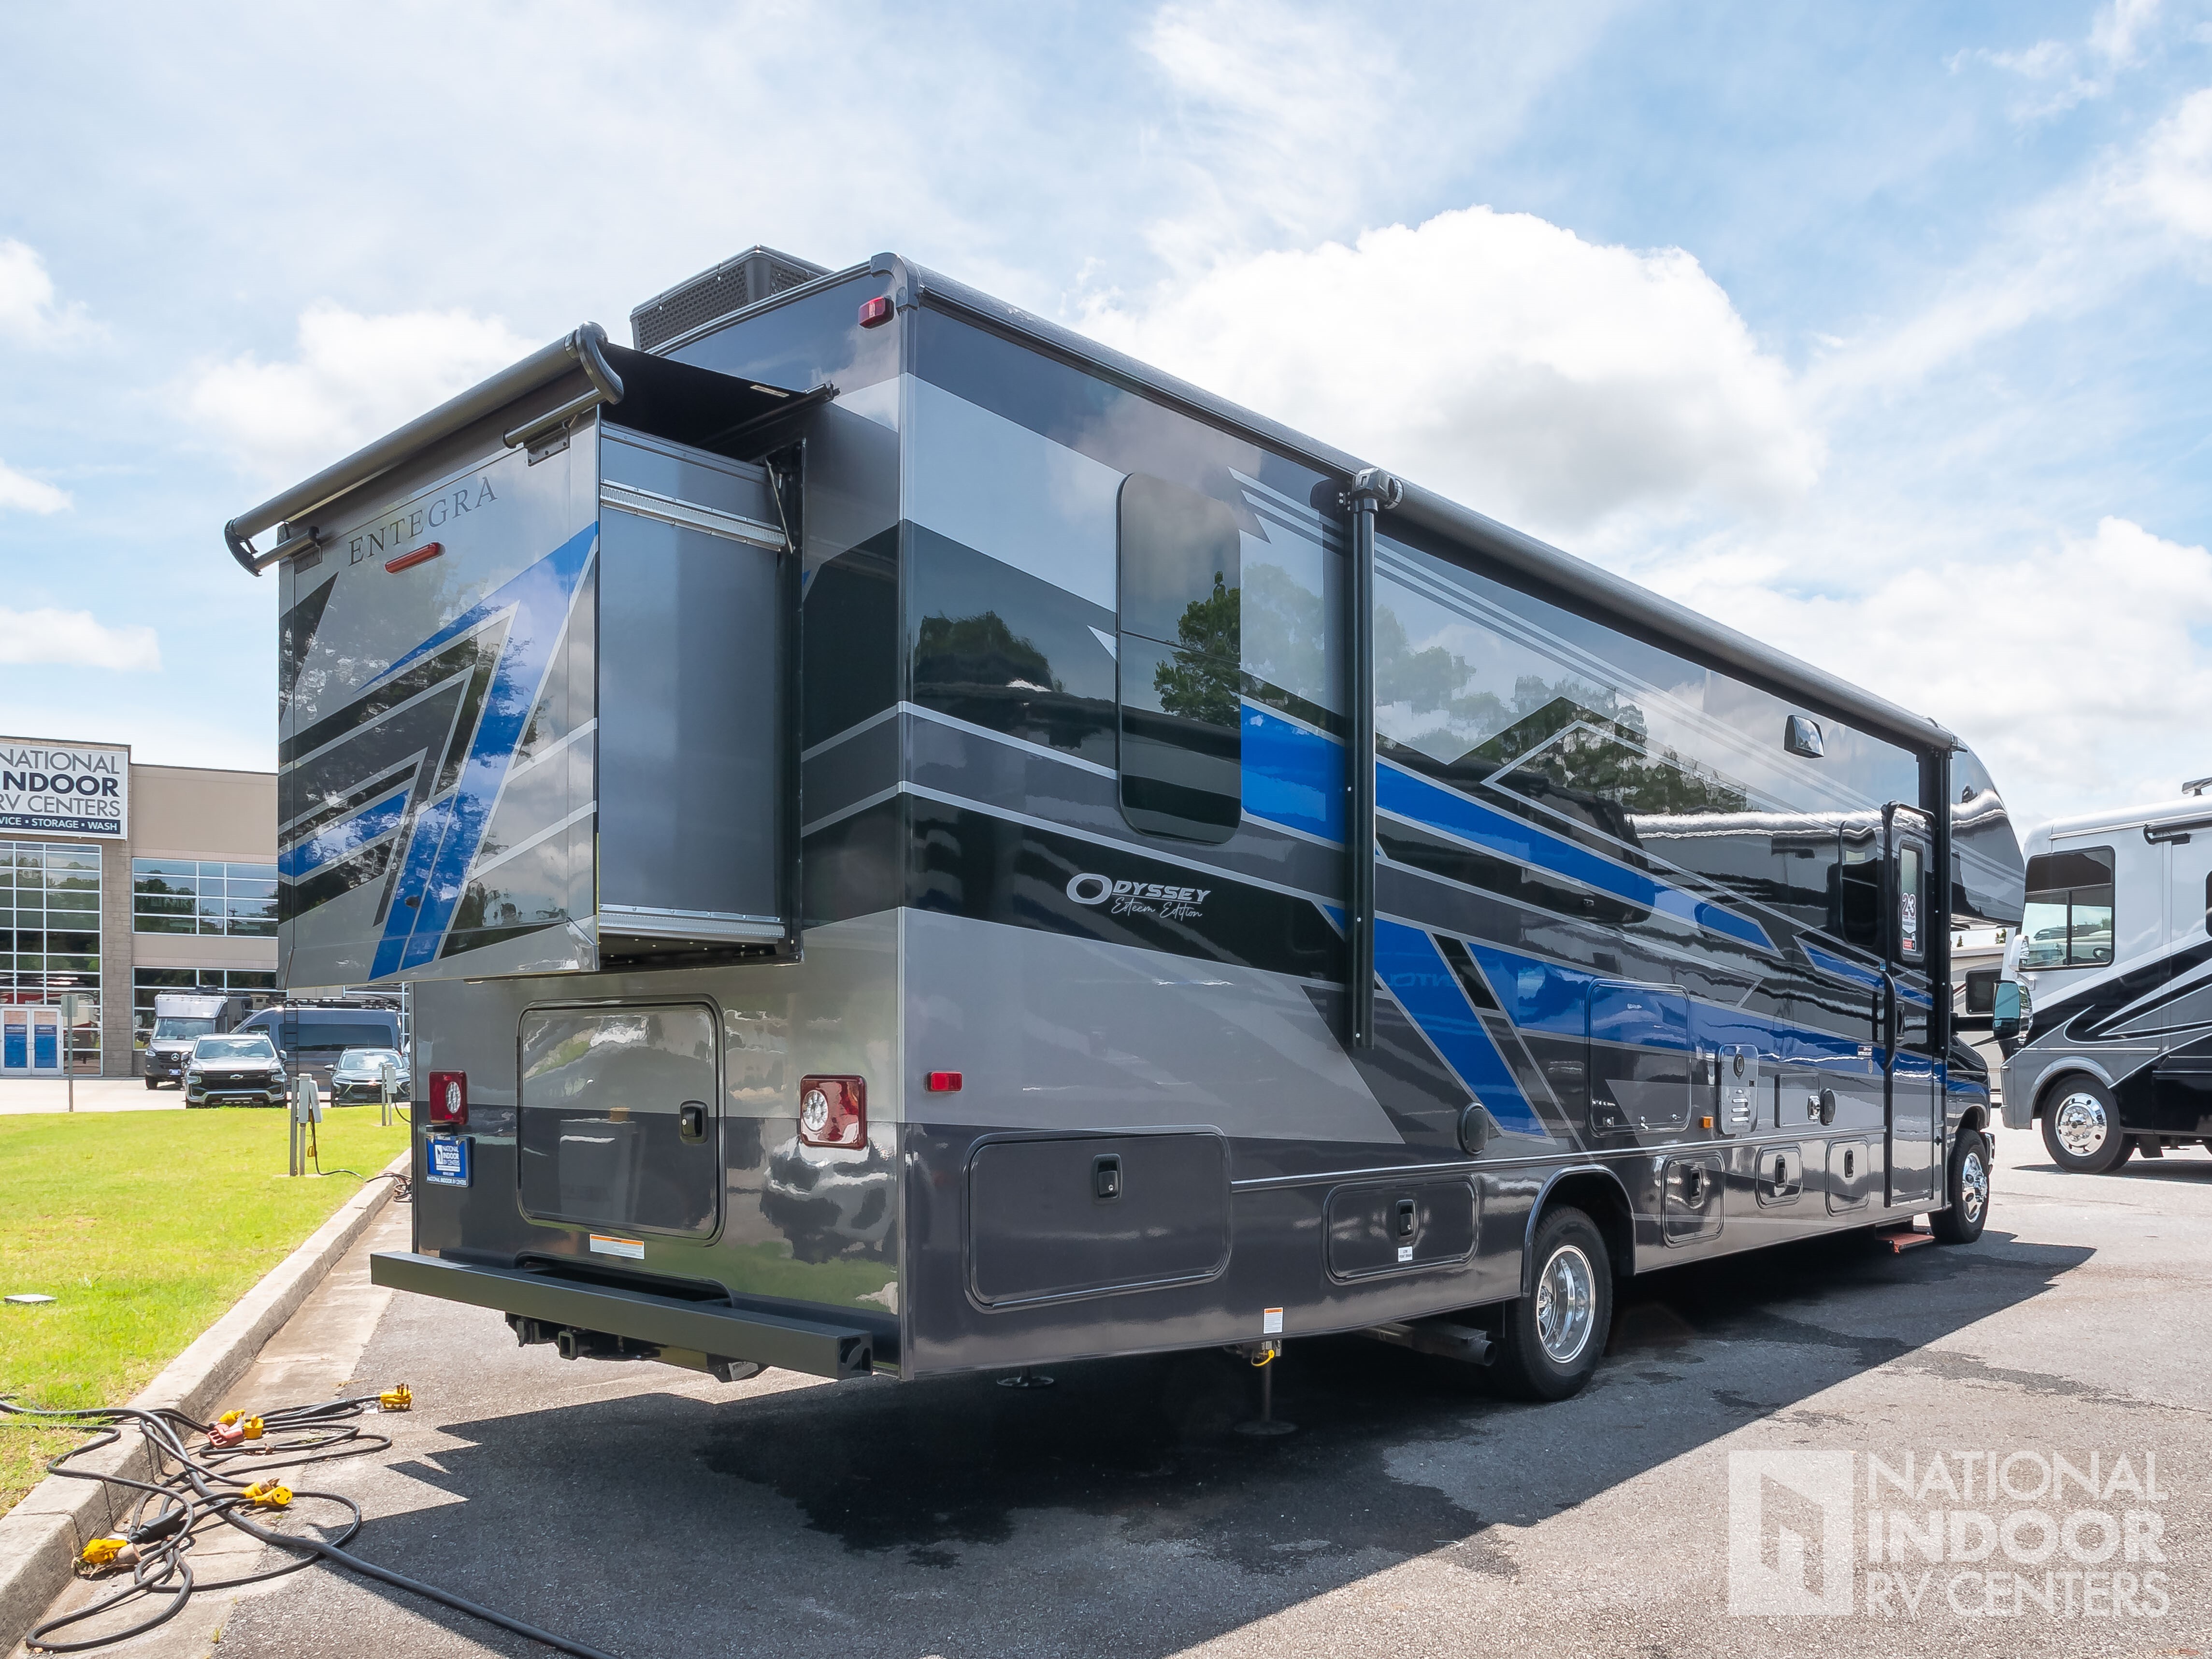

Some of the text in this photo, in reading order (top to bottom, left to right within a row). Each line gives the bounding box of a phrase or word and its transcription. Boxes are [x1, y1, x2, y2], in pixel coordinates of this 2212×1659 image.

[348, 476, 498, 567] ENTEGRA
[0, 749, 120, 774] NATIONAL
[3, 771, 120, 797] NDOOR
[0, 793, 121, 817] RV CENTERS
[0, 816, 117, 831] VICE STORAGE WASH
[1066, 873, 1211, 904] ODYSSEY
[1111, 897, 1203, 921] Esteem Edition
